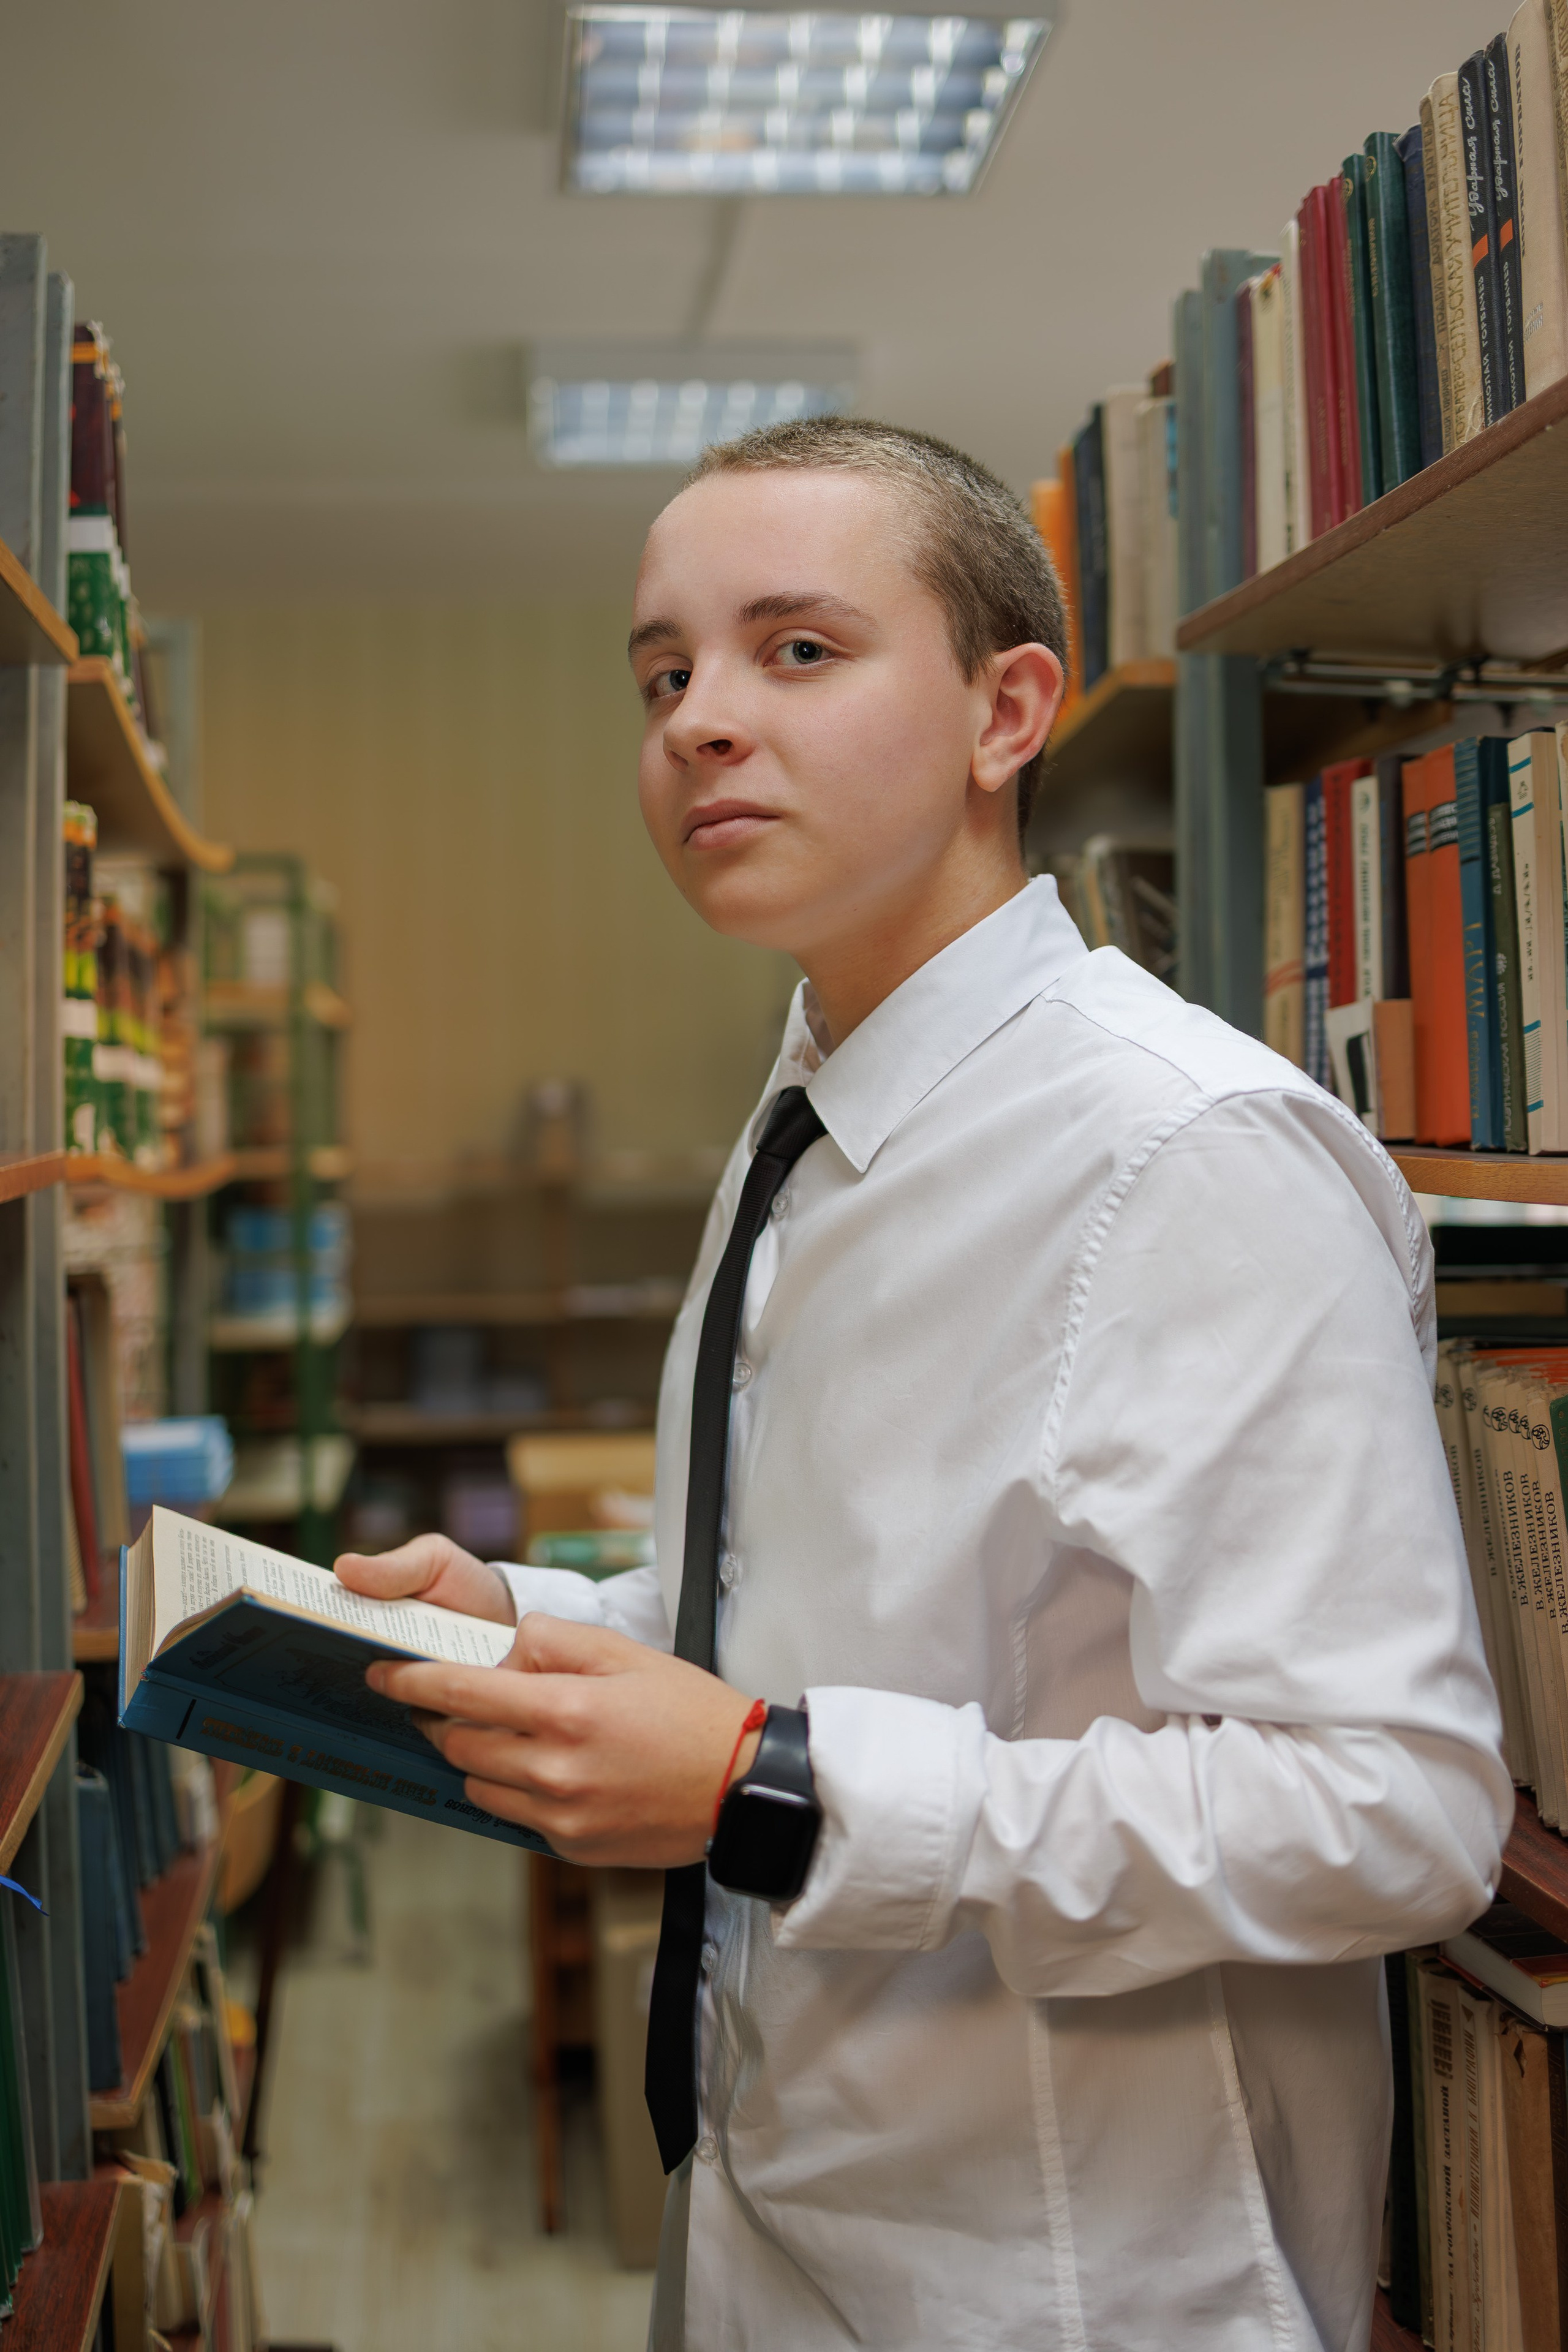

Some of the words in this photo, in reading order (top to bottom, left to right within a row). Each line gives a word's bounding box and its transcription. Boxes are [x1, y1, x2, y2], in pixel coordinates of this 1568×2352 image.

[1423, 119, 1436, 190] БУШУЕВА
[1438, 92, 1461, 252] УЧИТЕЛЬНИЦА
[1428, 199, 1442, 265] ДОКТОРА
[1447, 253, 1466, 368] СЕЛЬСКАЯ
[1478, 276, 1488, 347] ГОРБАЧЕВ
[1504, 262, 1512, 334] ГОРБАЧЕВ
[1483, 353, 1493, 426] НИКОЛАЙ
[1503, 1470, 1526, 1591] ЖЕЛЕЗНИКОВ
[1520, 1473, 1542, 1596] ЖЕЛЕЗНИКОВ
[1545, 1491, 1568, 1618] ЖЕЛЕЗНИКОВ
